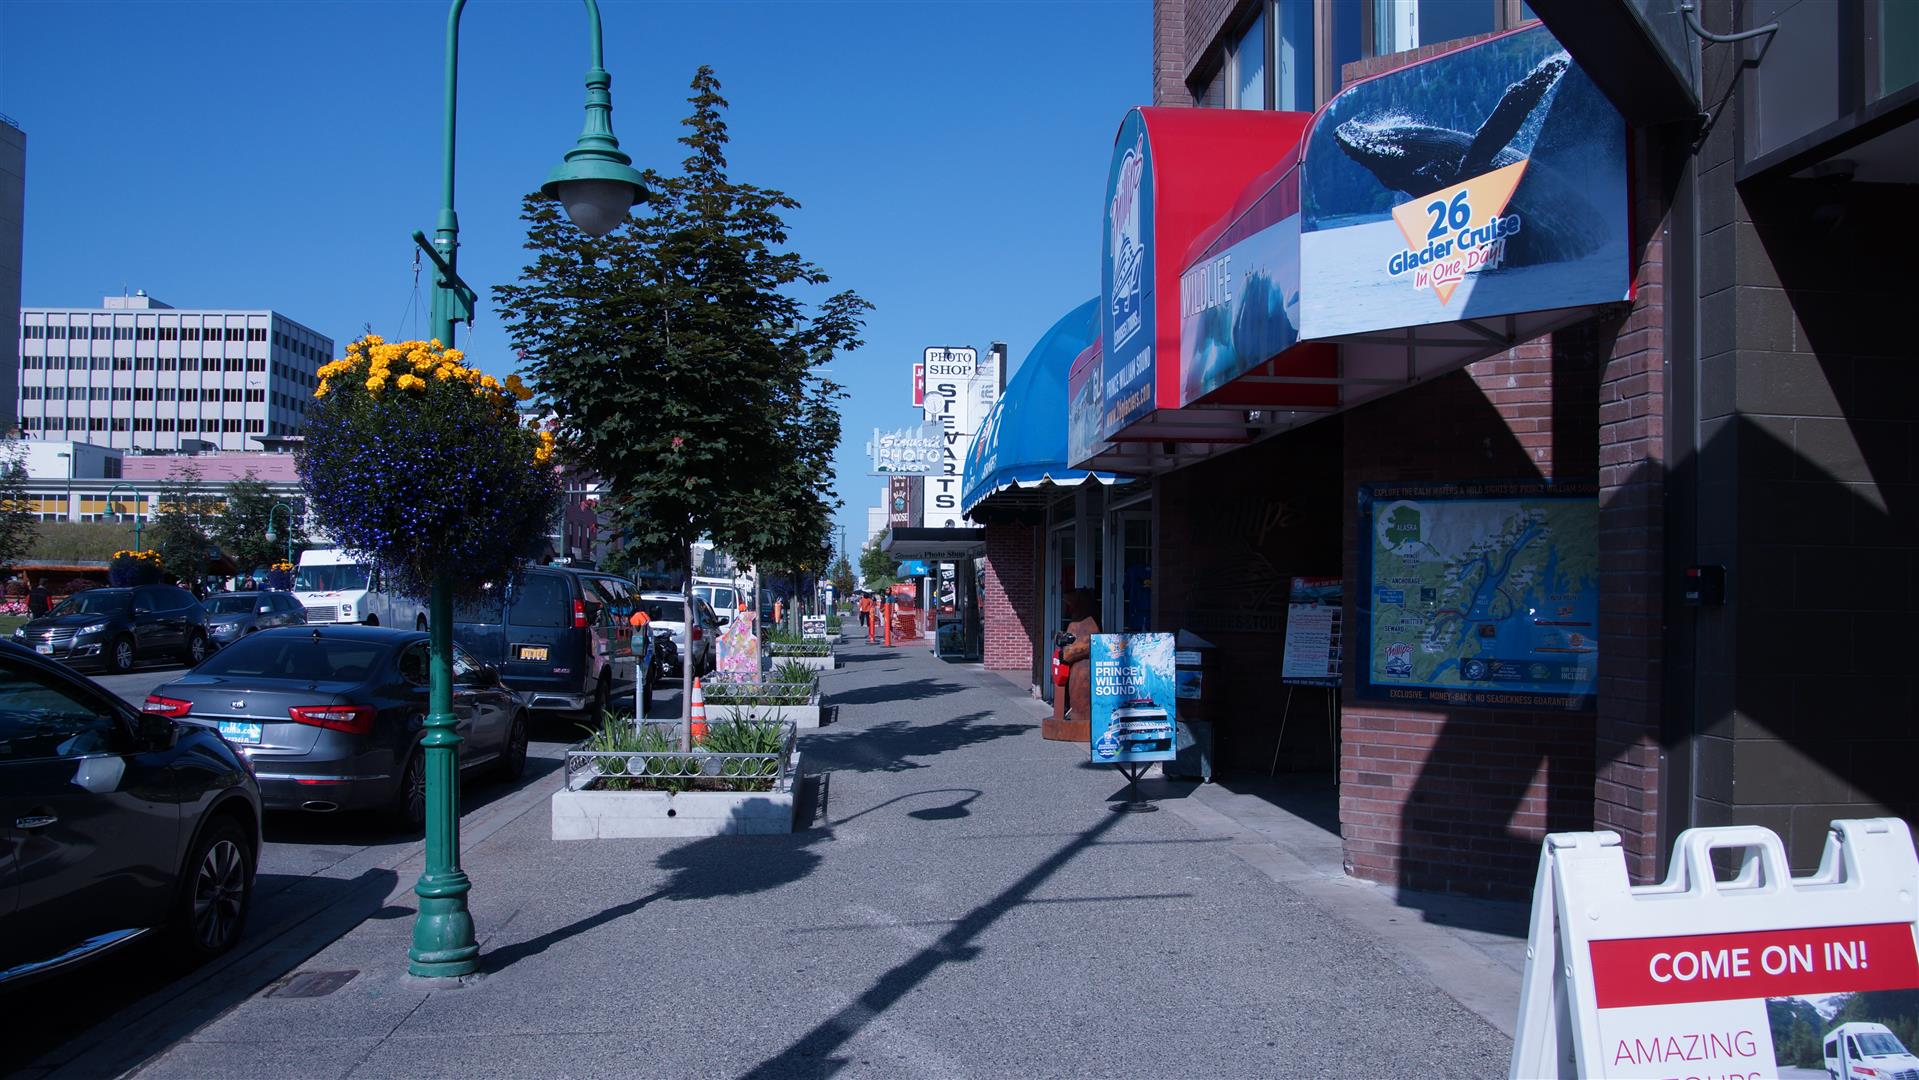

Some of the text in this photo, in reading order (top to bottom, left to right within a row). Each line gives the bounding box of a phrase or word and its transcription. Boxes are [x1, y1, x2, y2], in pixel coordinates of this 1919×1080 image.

[1427, 189, 1471, 240] 26
[1389, 216, 1519, 276] Glacier Cruise
[1416, 270, 1428, 287] In
[1433, 260, 1461, 281] One
[1181, 255, 1233, 319] WILDLIFE
[930, 352, 972, 362] PHOTO
[929, 365, 972, 375] SHOP
[1106, 345, 1151, 401] PRINCE WILLIAM SOUND
[880, 448, 941, 463] PHOTO
[892, 513, 908, 521] MOOSE
[1396, 523, 1417, 531] ALASKA
[1095, 667, 1138, 676] PRINCE
[1095, 676, 1144, 686] WILLIAM
[1095, 686, 1136, 696] SOUND
[1649, 940, 1868, 983] COME ON IN!
[1614, 1030, 1757, 1066] AMAZING
